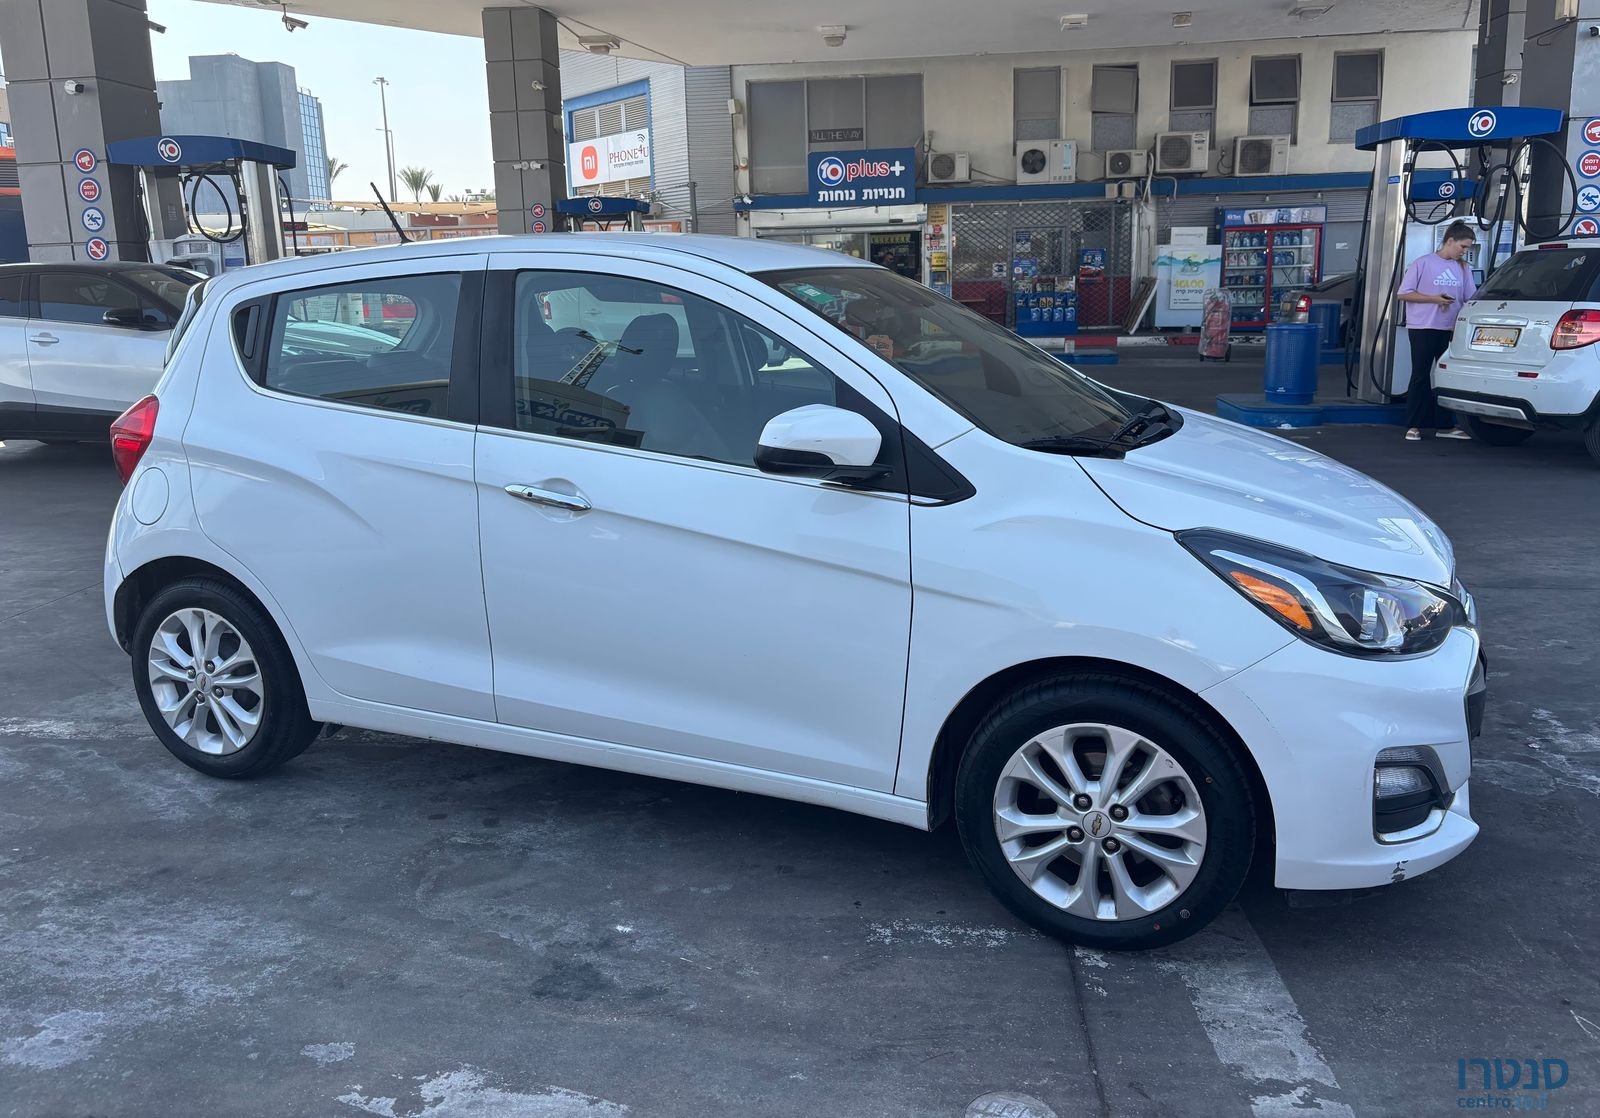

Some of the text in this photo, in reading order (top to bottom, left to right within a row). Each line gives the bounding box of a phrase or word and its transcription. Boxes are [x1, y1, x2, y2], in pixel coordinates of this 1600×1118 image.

[1470, 115, 1495, 134] 10
[159, 140, 179, 158] 10
[819, 160, 843, 182] 10
[818, 187, 905, 201] חנויות נוחות
